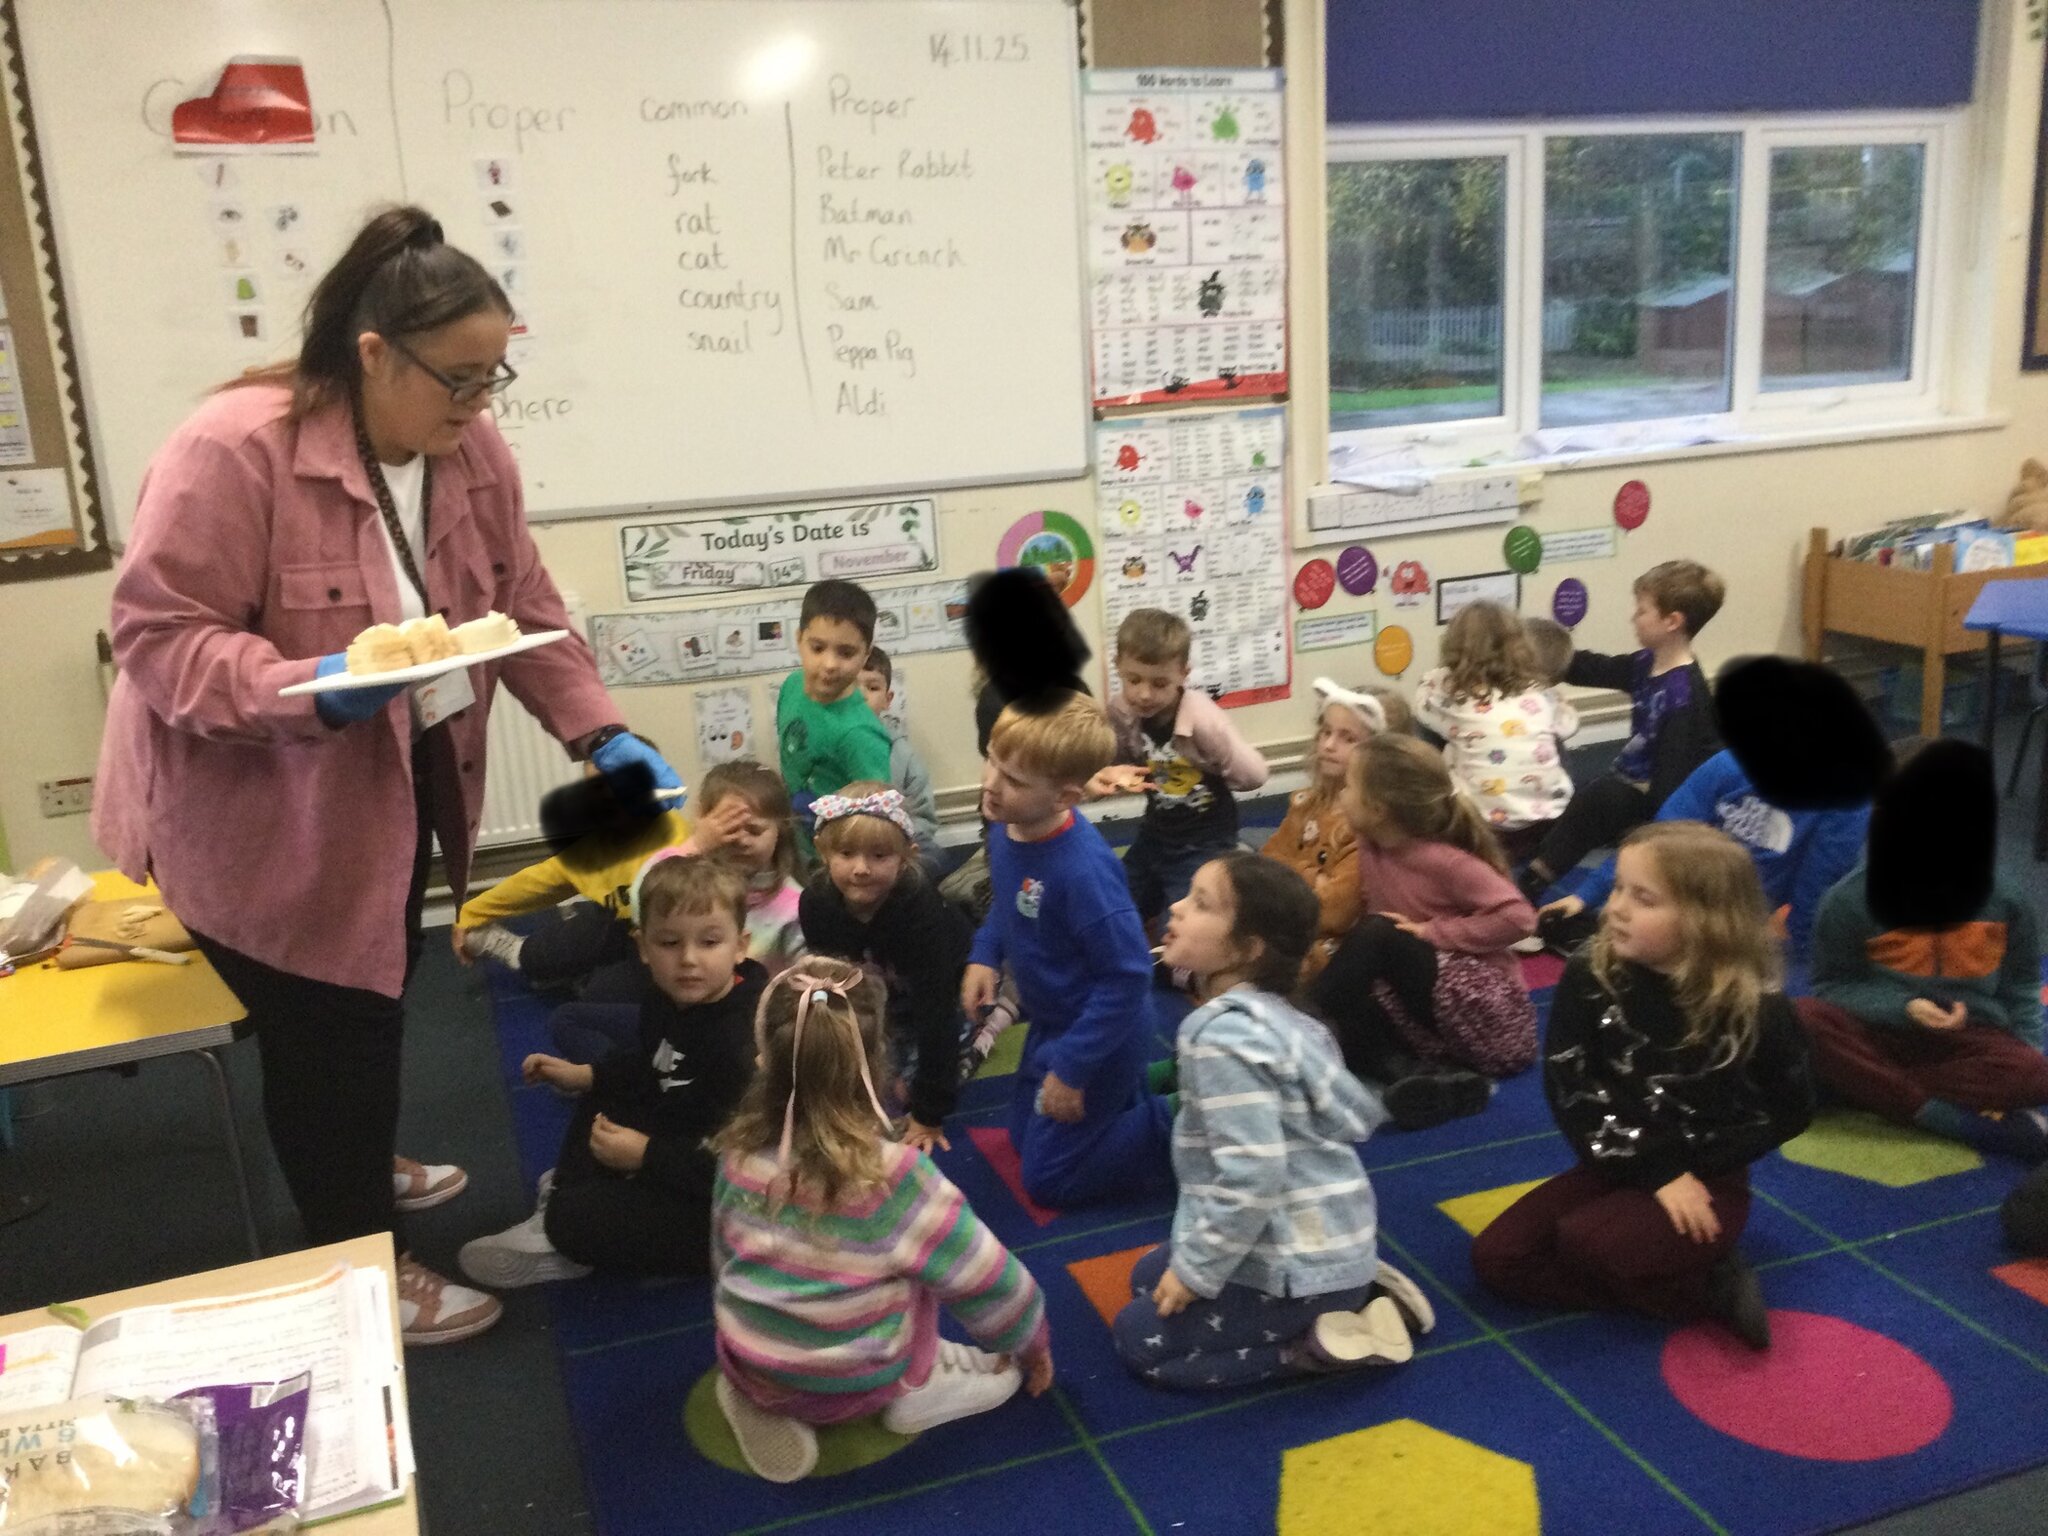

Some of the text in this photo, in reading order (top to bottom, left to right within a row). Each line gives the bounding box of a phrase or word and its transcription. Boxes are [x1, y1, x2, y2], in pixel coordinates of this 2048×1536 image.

[442, 69, 576, 153] Proper
[828, 73, 916, 134] Proper
[666, 152, 717, 197] fork
[816, 144, 881, 180] Peter
[675, 202, 720, 236] rat
[819, 193, 914, 226] Batman
[679, 240, 728, 271] cat
[823, 236, 861, 265] Mr
[679, 280, 783, 336] country
[825, 280, 881, 312] Sam
[687, 319, 753, 354] snail
[827, 323, 917, 379] Peppa Pig
[836, 380, 887, 417] Aldi
[701, 520, 870, 552] Today's Date is
[683, 564, 735, 584] Friday
[832, 549, 910, 569] November
